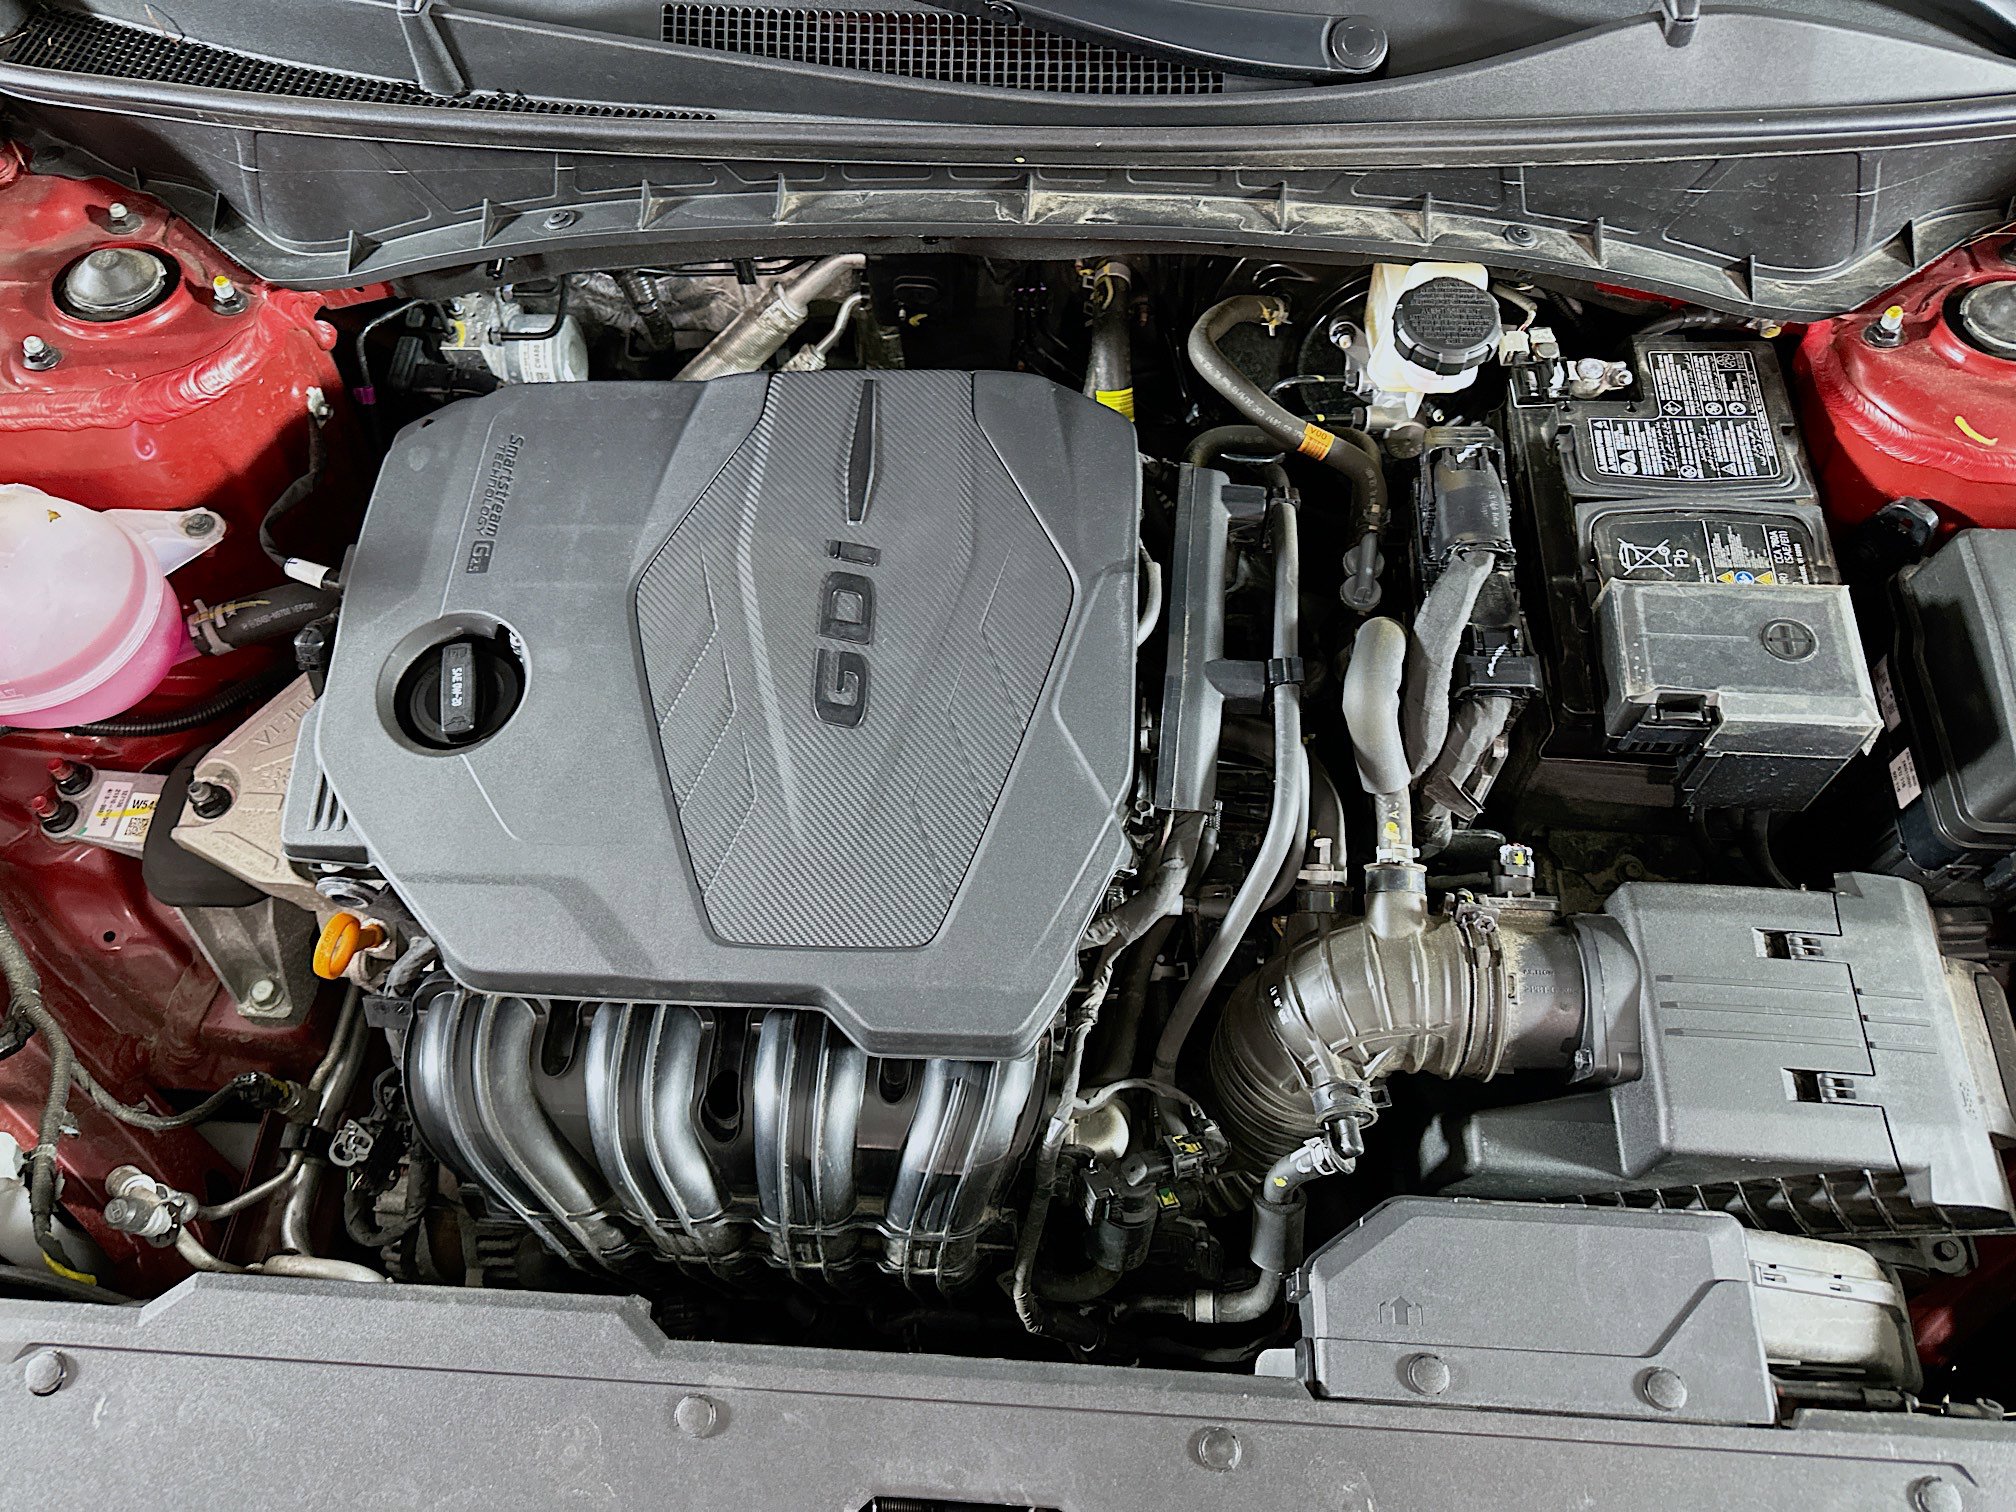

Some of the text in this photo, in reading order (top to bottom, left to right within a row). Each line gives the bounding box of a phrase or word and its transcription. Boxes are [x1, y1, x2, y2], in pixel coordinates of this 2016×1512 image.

[476, 444, 507, 536] TECHNOLOGY
[486, 433, 524, 537] Smartstream
[1673, 549, 1690, 568] Pb
[1773, 549, 1784, 564] CCA
[451, 667, 463, 707] SAE 0W-20
